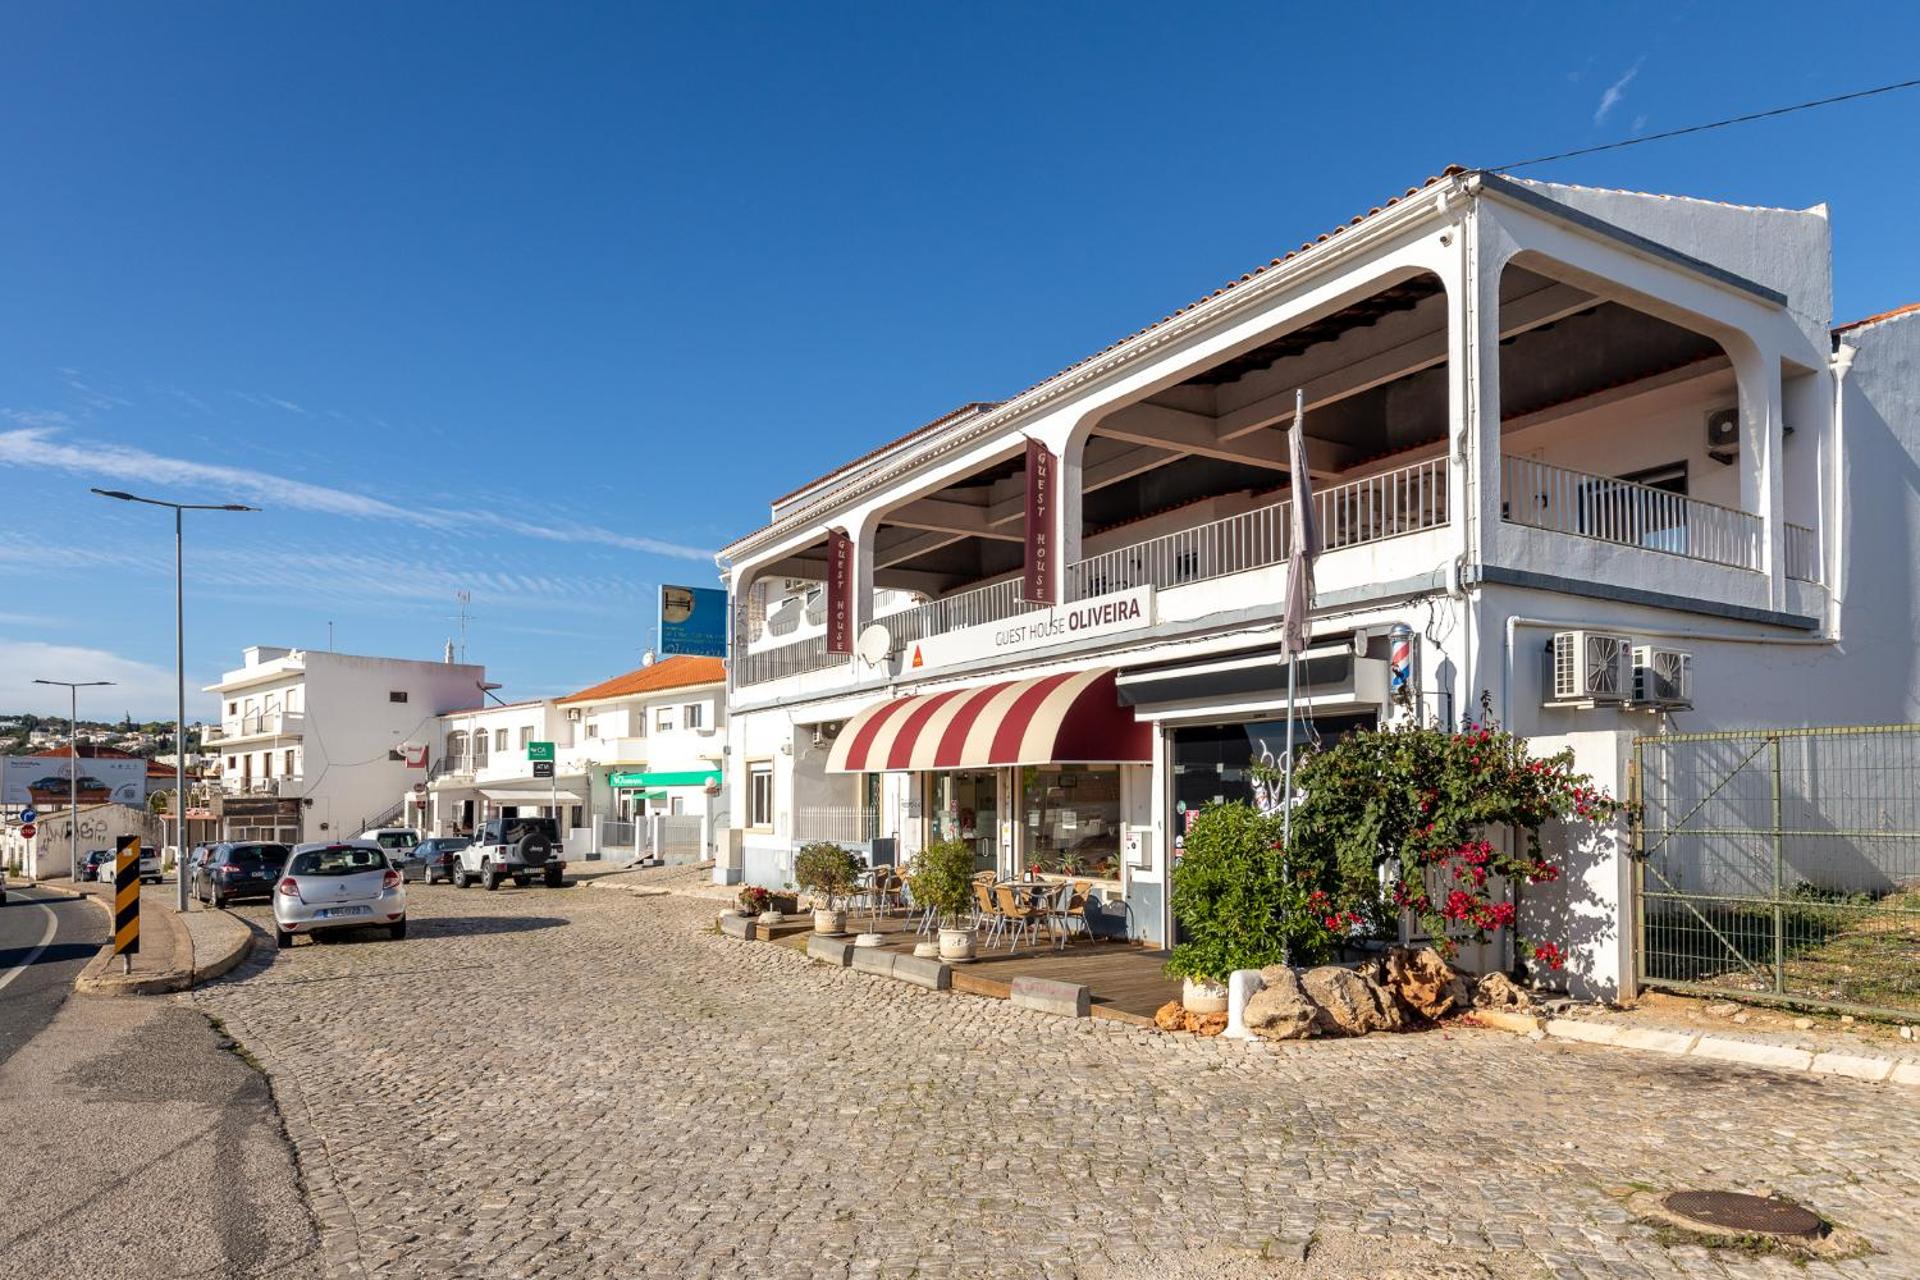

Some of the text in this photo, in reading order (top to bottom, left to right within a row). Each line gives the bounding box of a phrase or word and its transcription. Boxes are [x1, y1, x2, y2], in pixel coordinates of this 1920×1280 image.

[1035, 452, 1047, 599] GUEST HOUSE
[836, 539, 846, 650] GUEST HOUSE
[995, 597, 1141, 647] GUEST HOUSE OLIVEIRA
